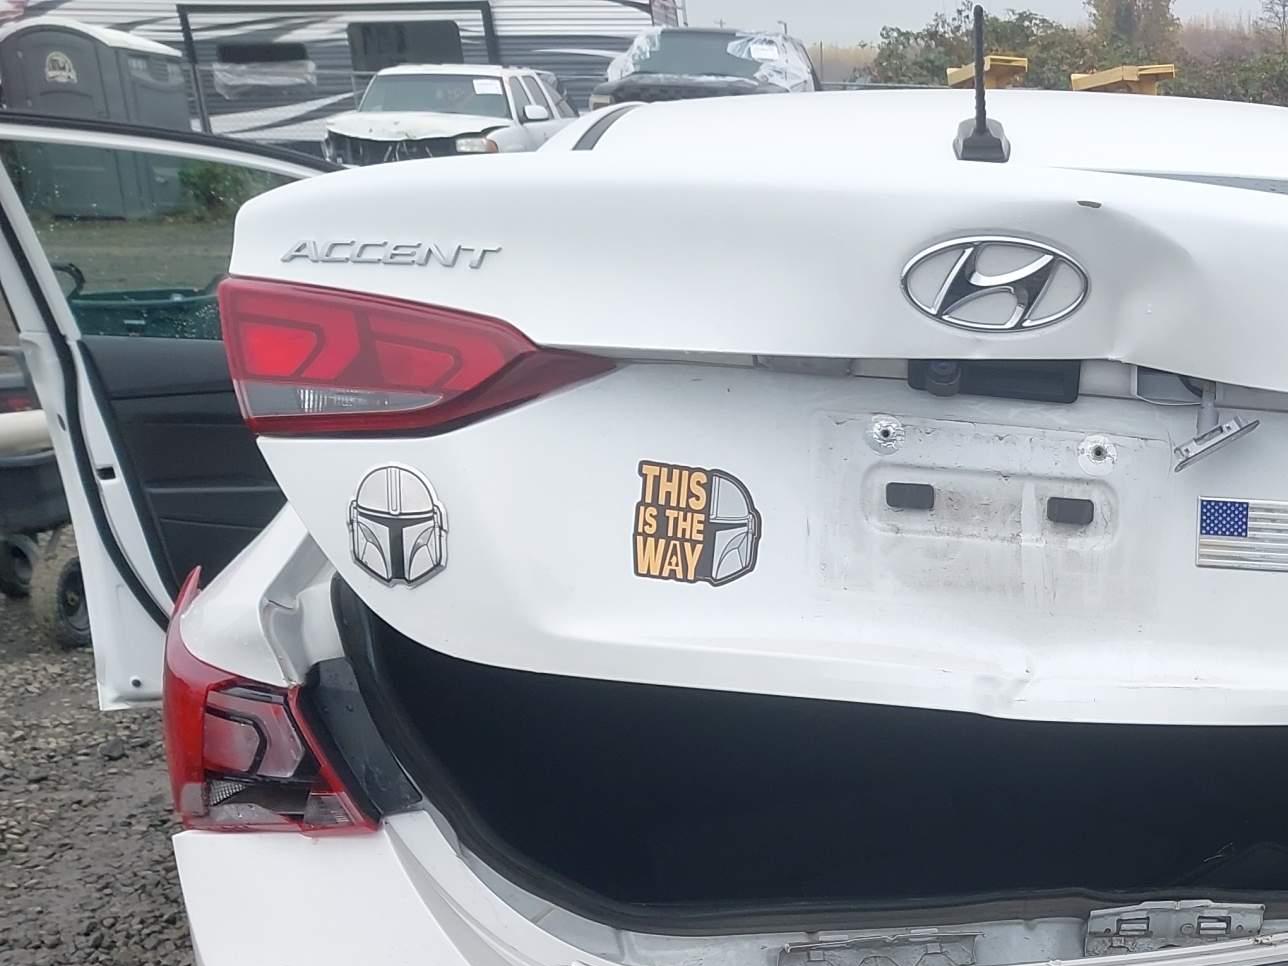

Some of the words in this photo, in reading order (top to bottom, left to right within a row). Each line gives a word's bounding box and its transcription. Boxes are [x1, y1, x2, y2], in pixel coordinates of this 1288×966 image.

[280, 239, 502, 270] ACCENT
[642, 463, 708, 511] THIS
[637, 505, 658, 535] IS
[665, 508, 706, 541] THE
[636, 535, 704, 580] WAY
